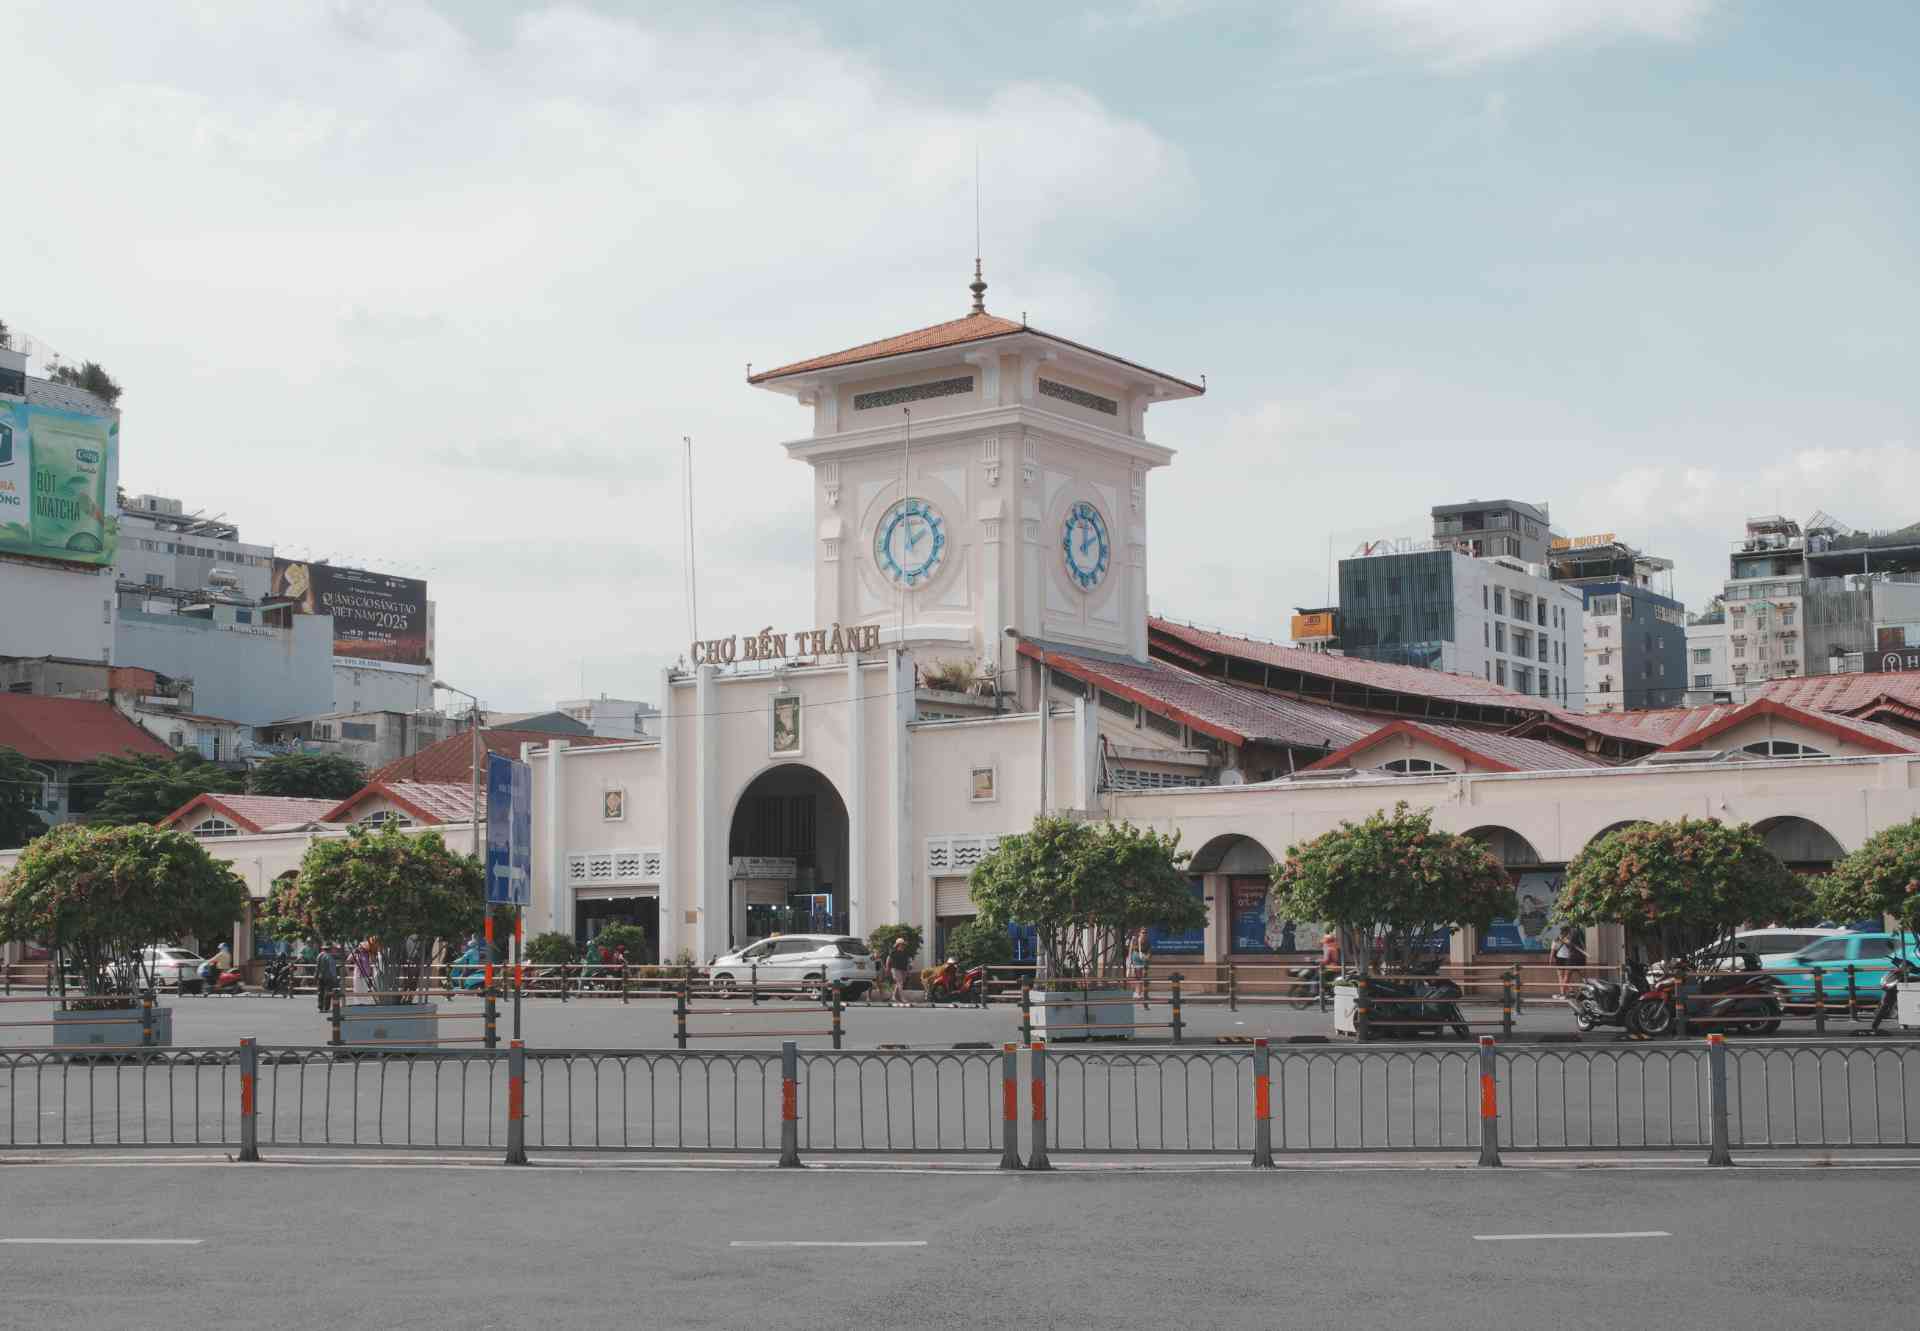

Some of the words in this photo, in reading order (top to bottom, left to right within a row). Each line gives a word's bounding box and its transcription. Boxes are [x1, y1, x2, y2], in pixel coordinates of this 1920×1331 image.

[37, 496, 80, 520] MATCHA
[376, 611, 408, 630] 2025
[691, 634, 736, 665] CHỢ
[742, 626, 788, 661] BẾN
[795, 622, 881, 656] THÀNH
